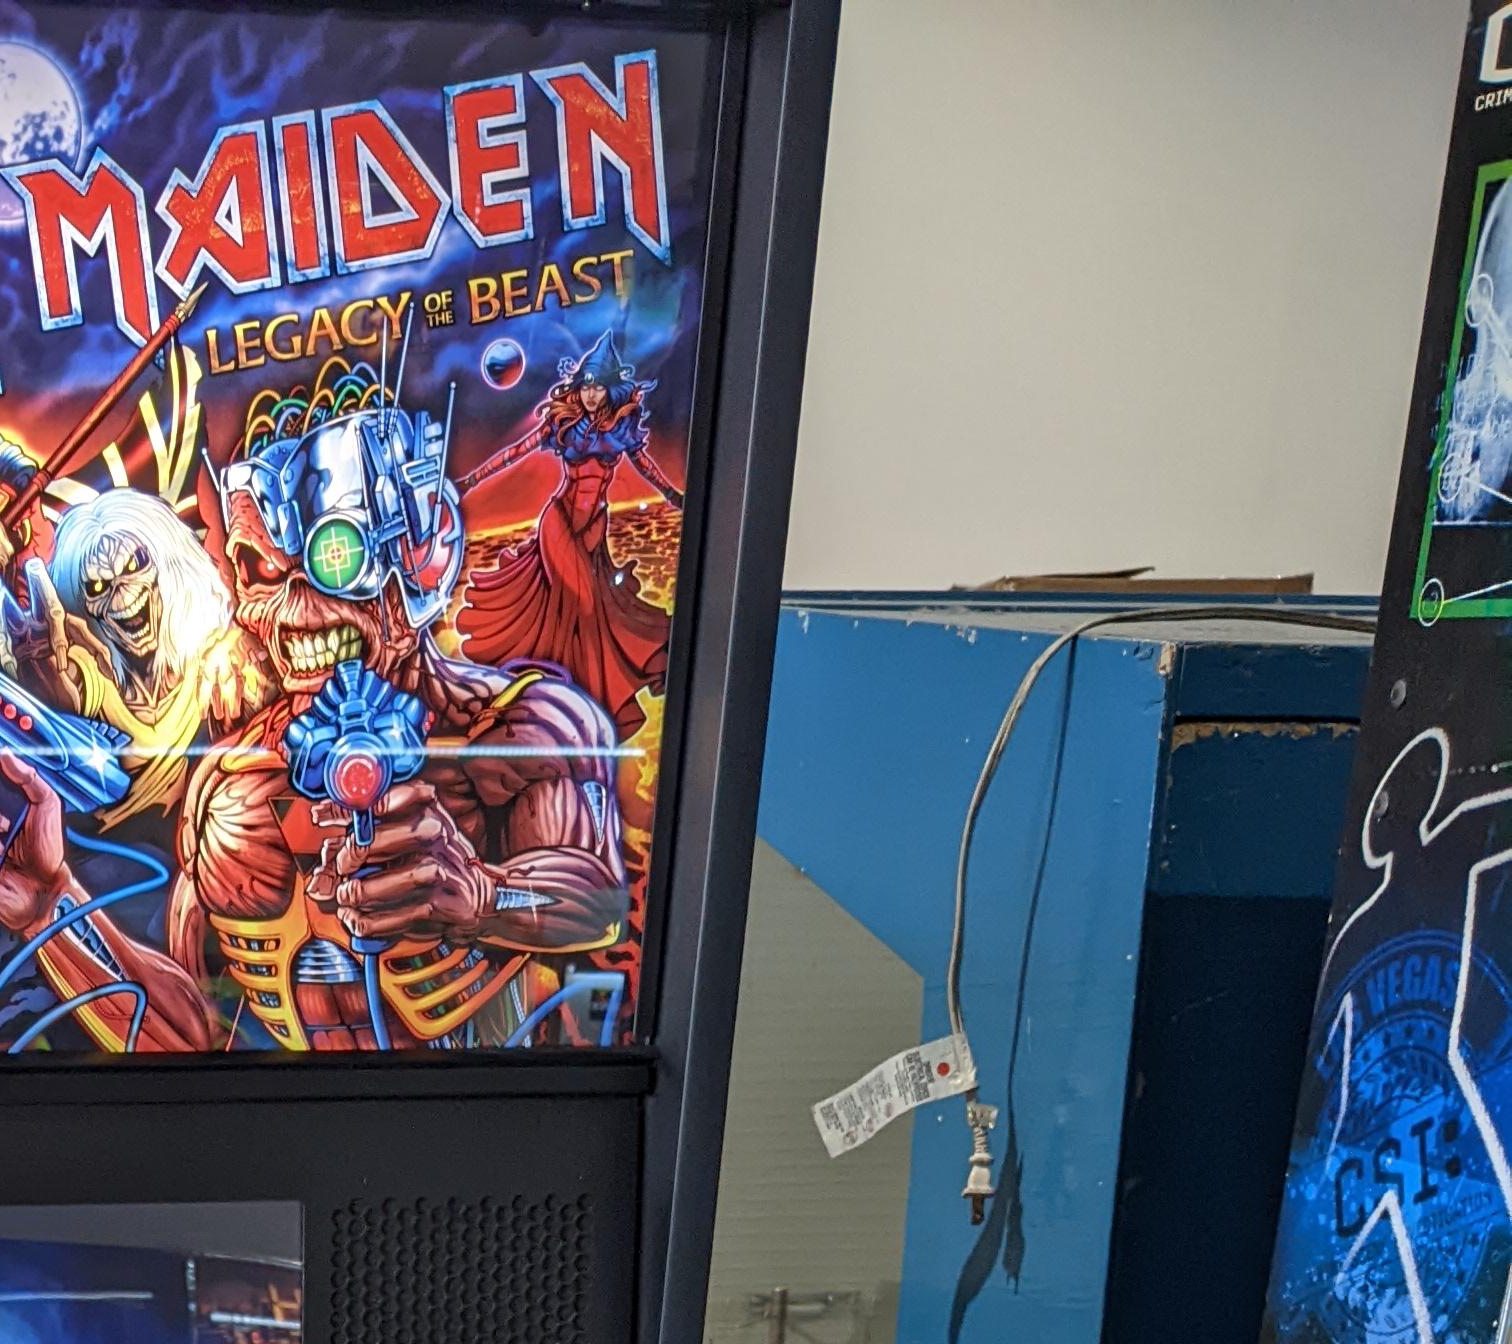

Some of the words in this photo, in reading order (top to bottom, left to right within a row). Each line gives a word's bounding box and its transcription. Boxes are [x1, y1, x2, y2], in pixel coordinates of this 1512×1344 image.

[423, 290, 453, 313] OF
[469, 251, 635, 325] BEAST
[206, 289, 409, 376] LEGACY
[426, 310, 454, 328] THE
